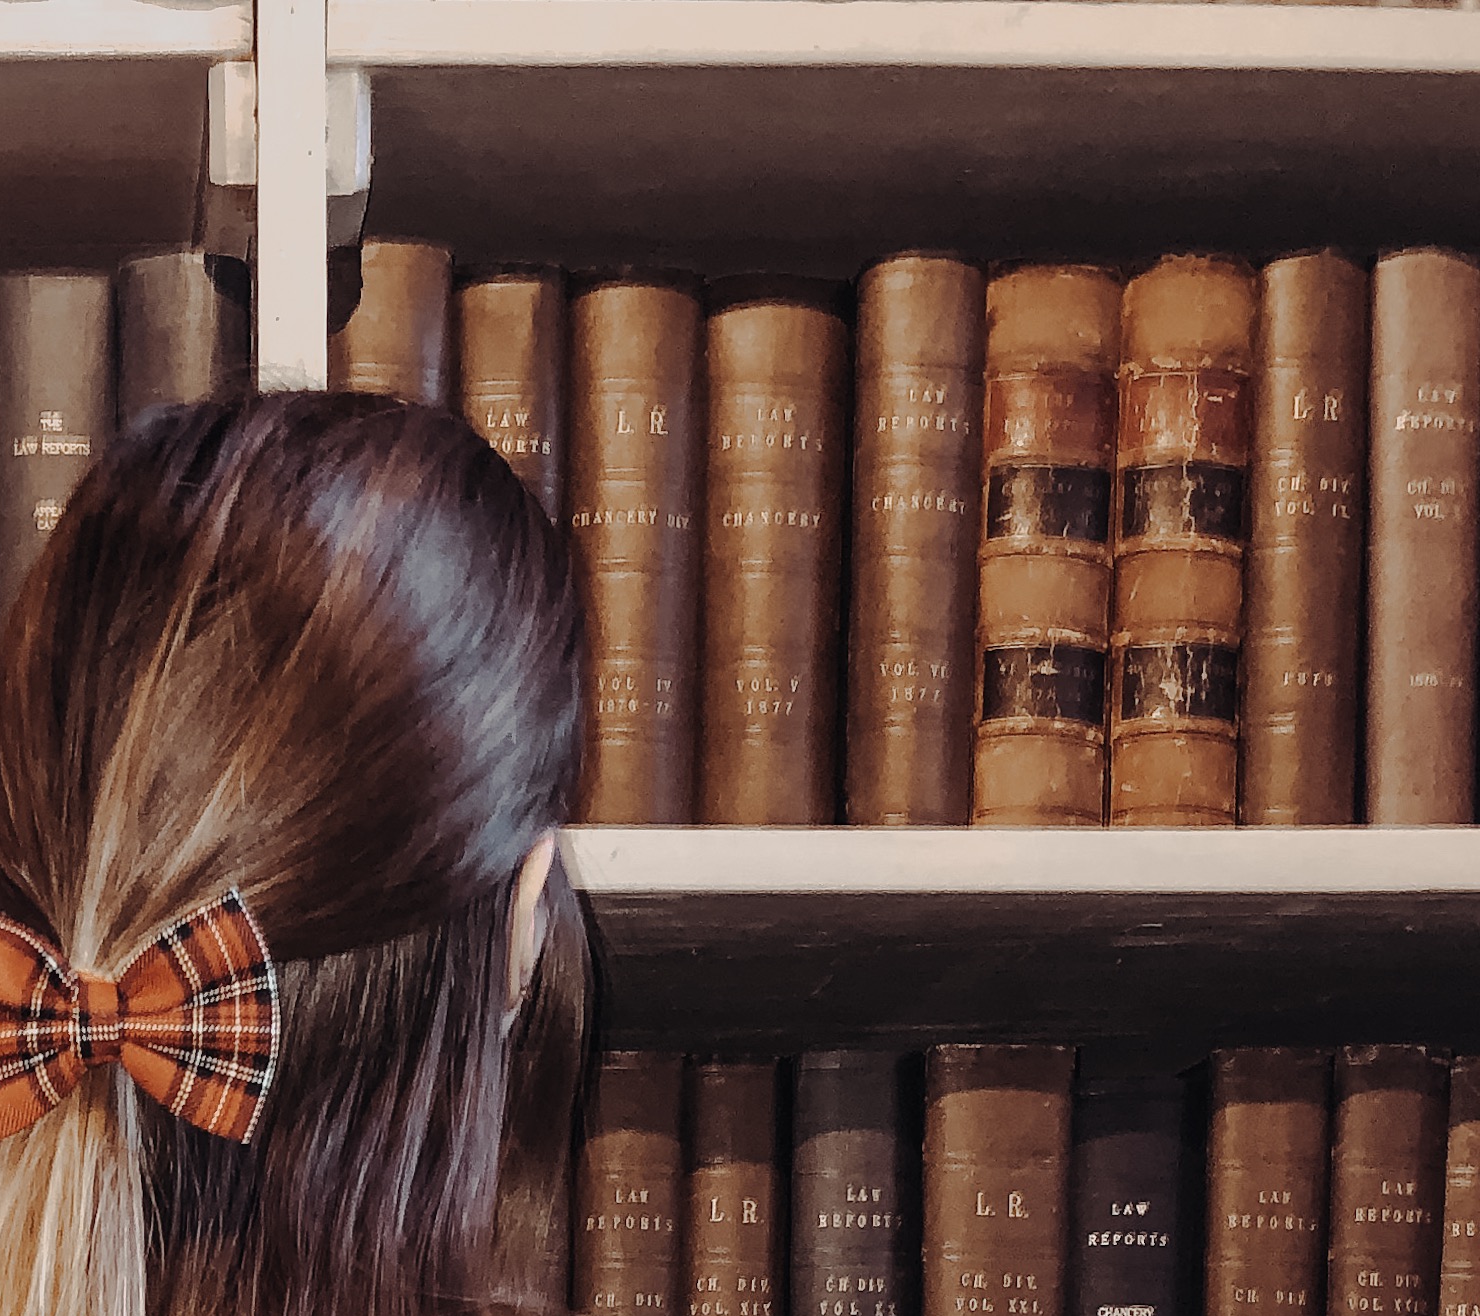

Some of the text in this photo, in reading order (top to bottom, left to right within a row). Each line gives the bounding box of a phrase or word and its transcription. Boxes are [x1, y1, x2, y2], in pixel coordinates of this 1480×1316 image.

[487, 413, 529, 428] LAW
[1112, 1202, 1149, 1215] LAW
[1088, 1233, 1168, 1246] REPORTS
